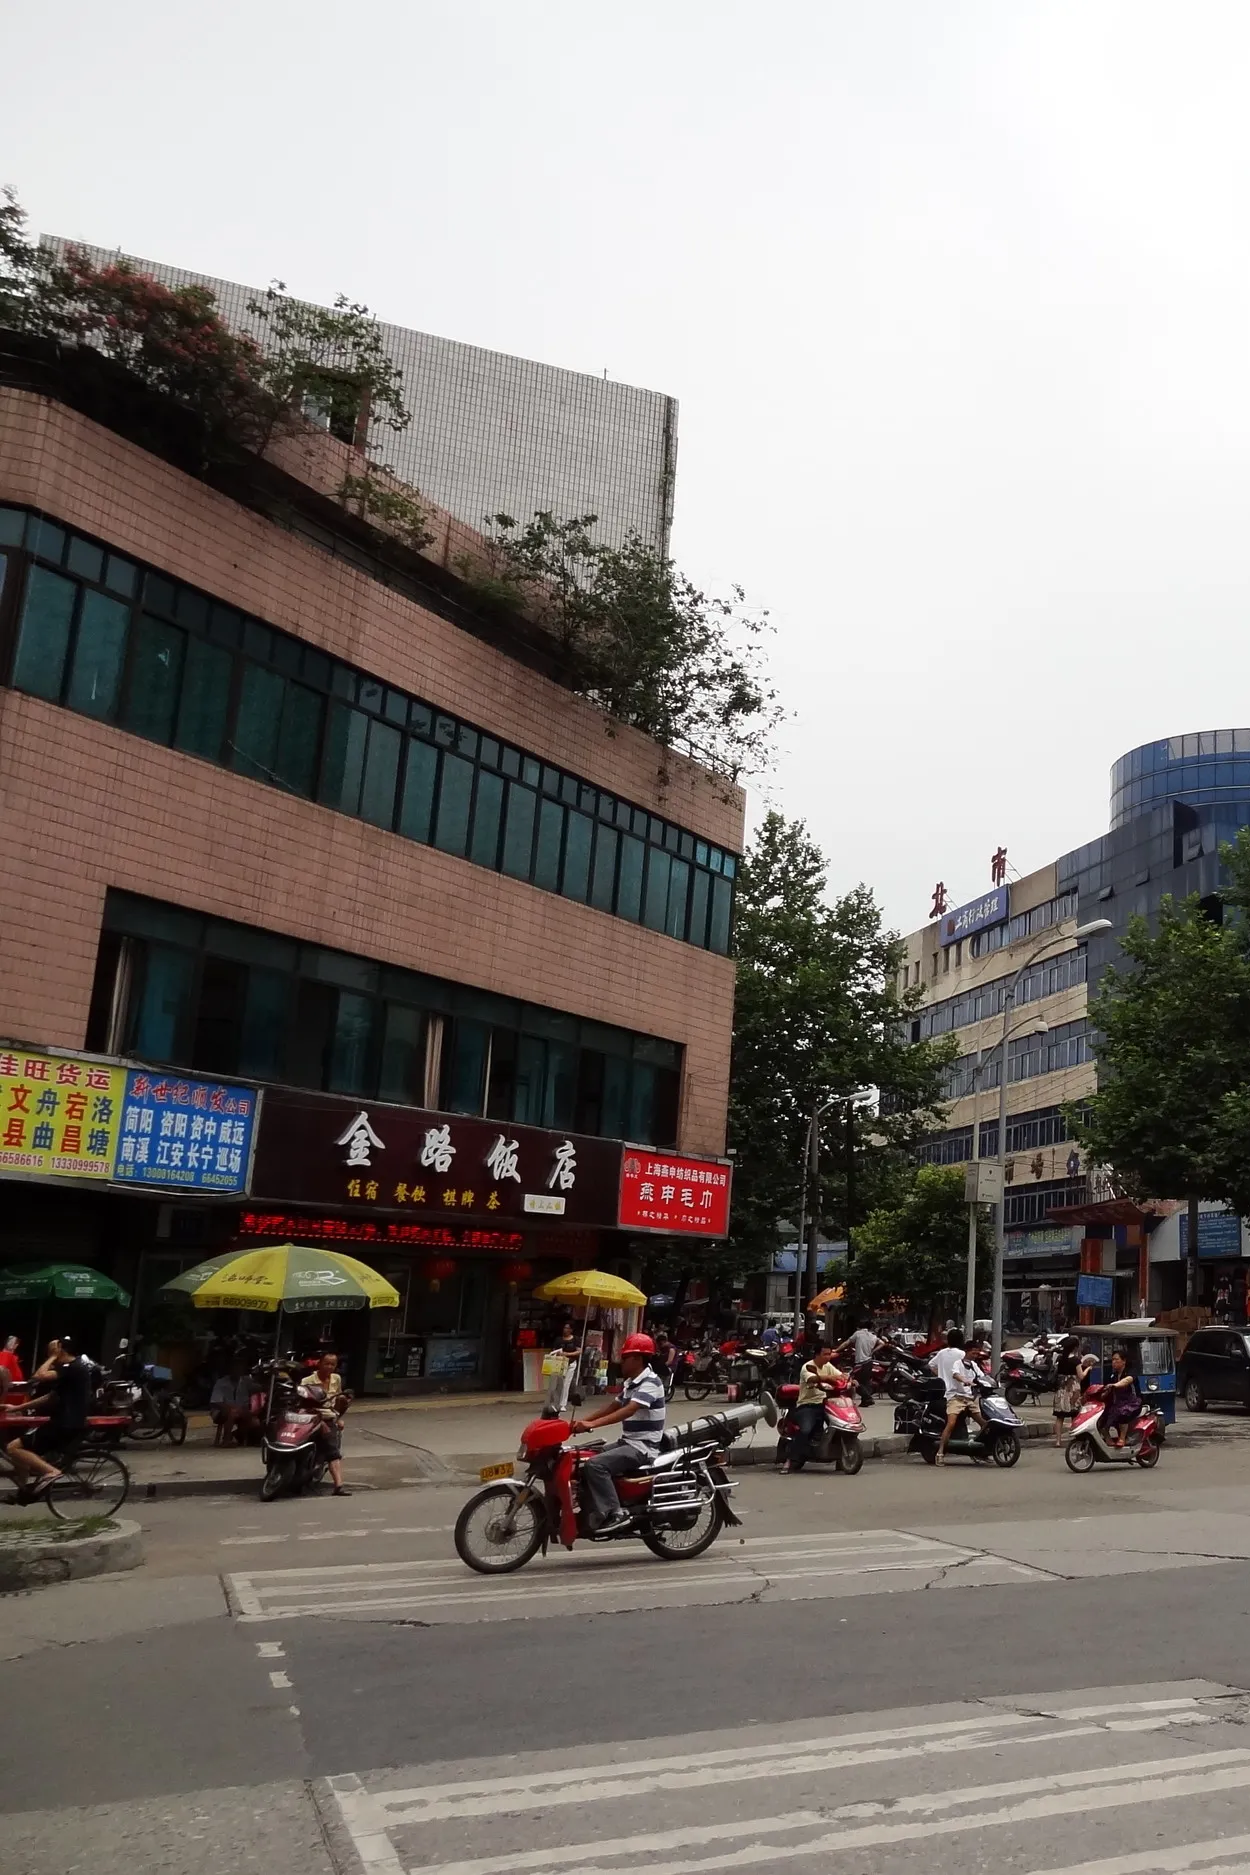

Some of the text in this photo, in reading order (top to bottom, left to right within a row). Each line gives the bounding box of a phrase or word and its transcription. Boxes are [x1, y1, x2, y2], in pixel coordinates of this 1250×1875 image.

[129, 1074, 251, 1118] 新世纪顺发公司
[125, 1105, 245, 1146] 简阳 资阳 资中 威远
[120, 1135, 241, 1174] 南溪 江安 长宁 巡场
[336, 1110, 579, 1190] 金路饭店
[644, 1162, 727, 1187] 上海燕申纺织品有限公司
[394, 1182, 427, 1204] 餐饮
[442, 1187, 475, 1208] 棋牌
[639, 1182, 713, 1209] 燕申毛巾
